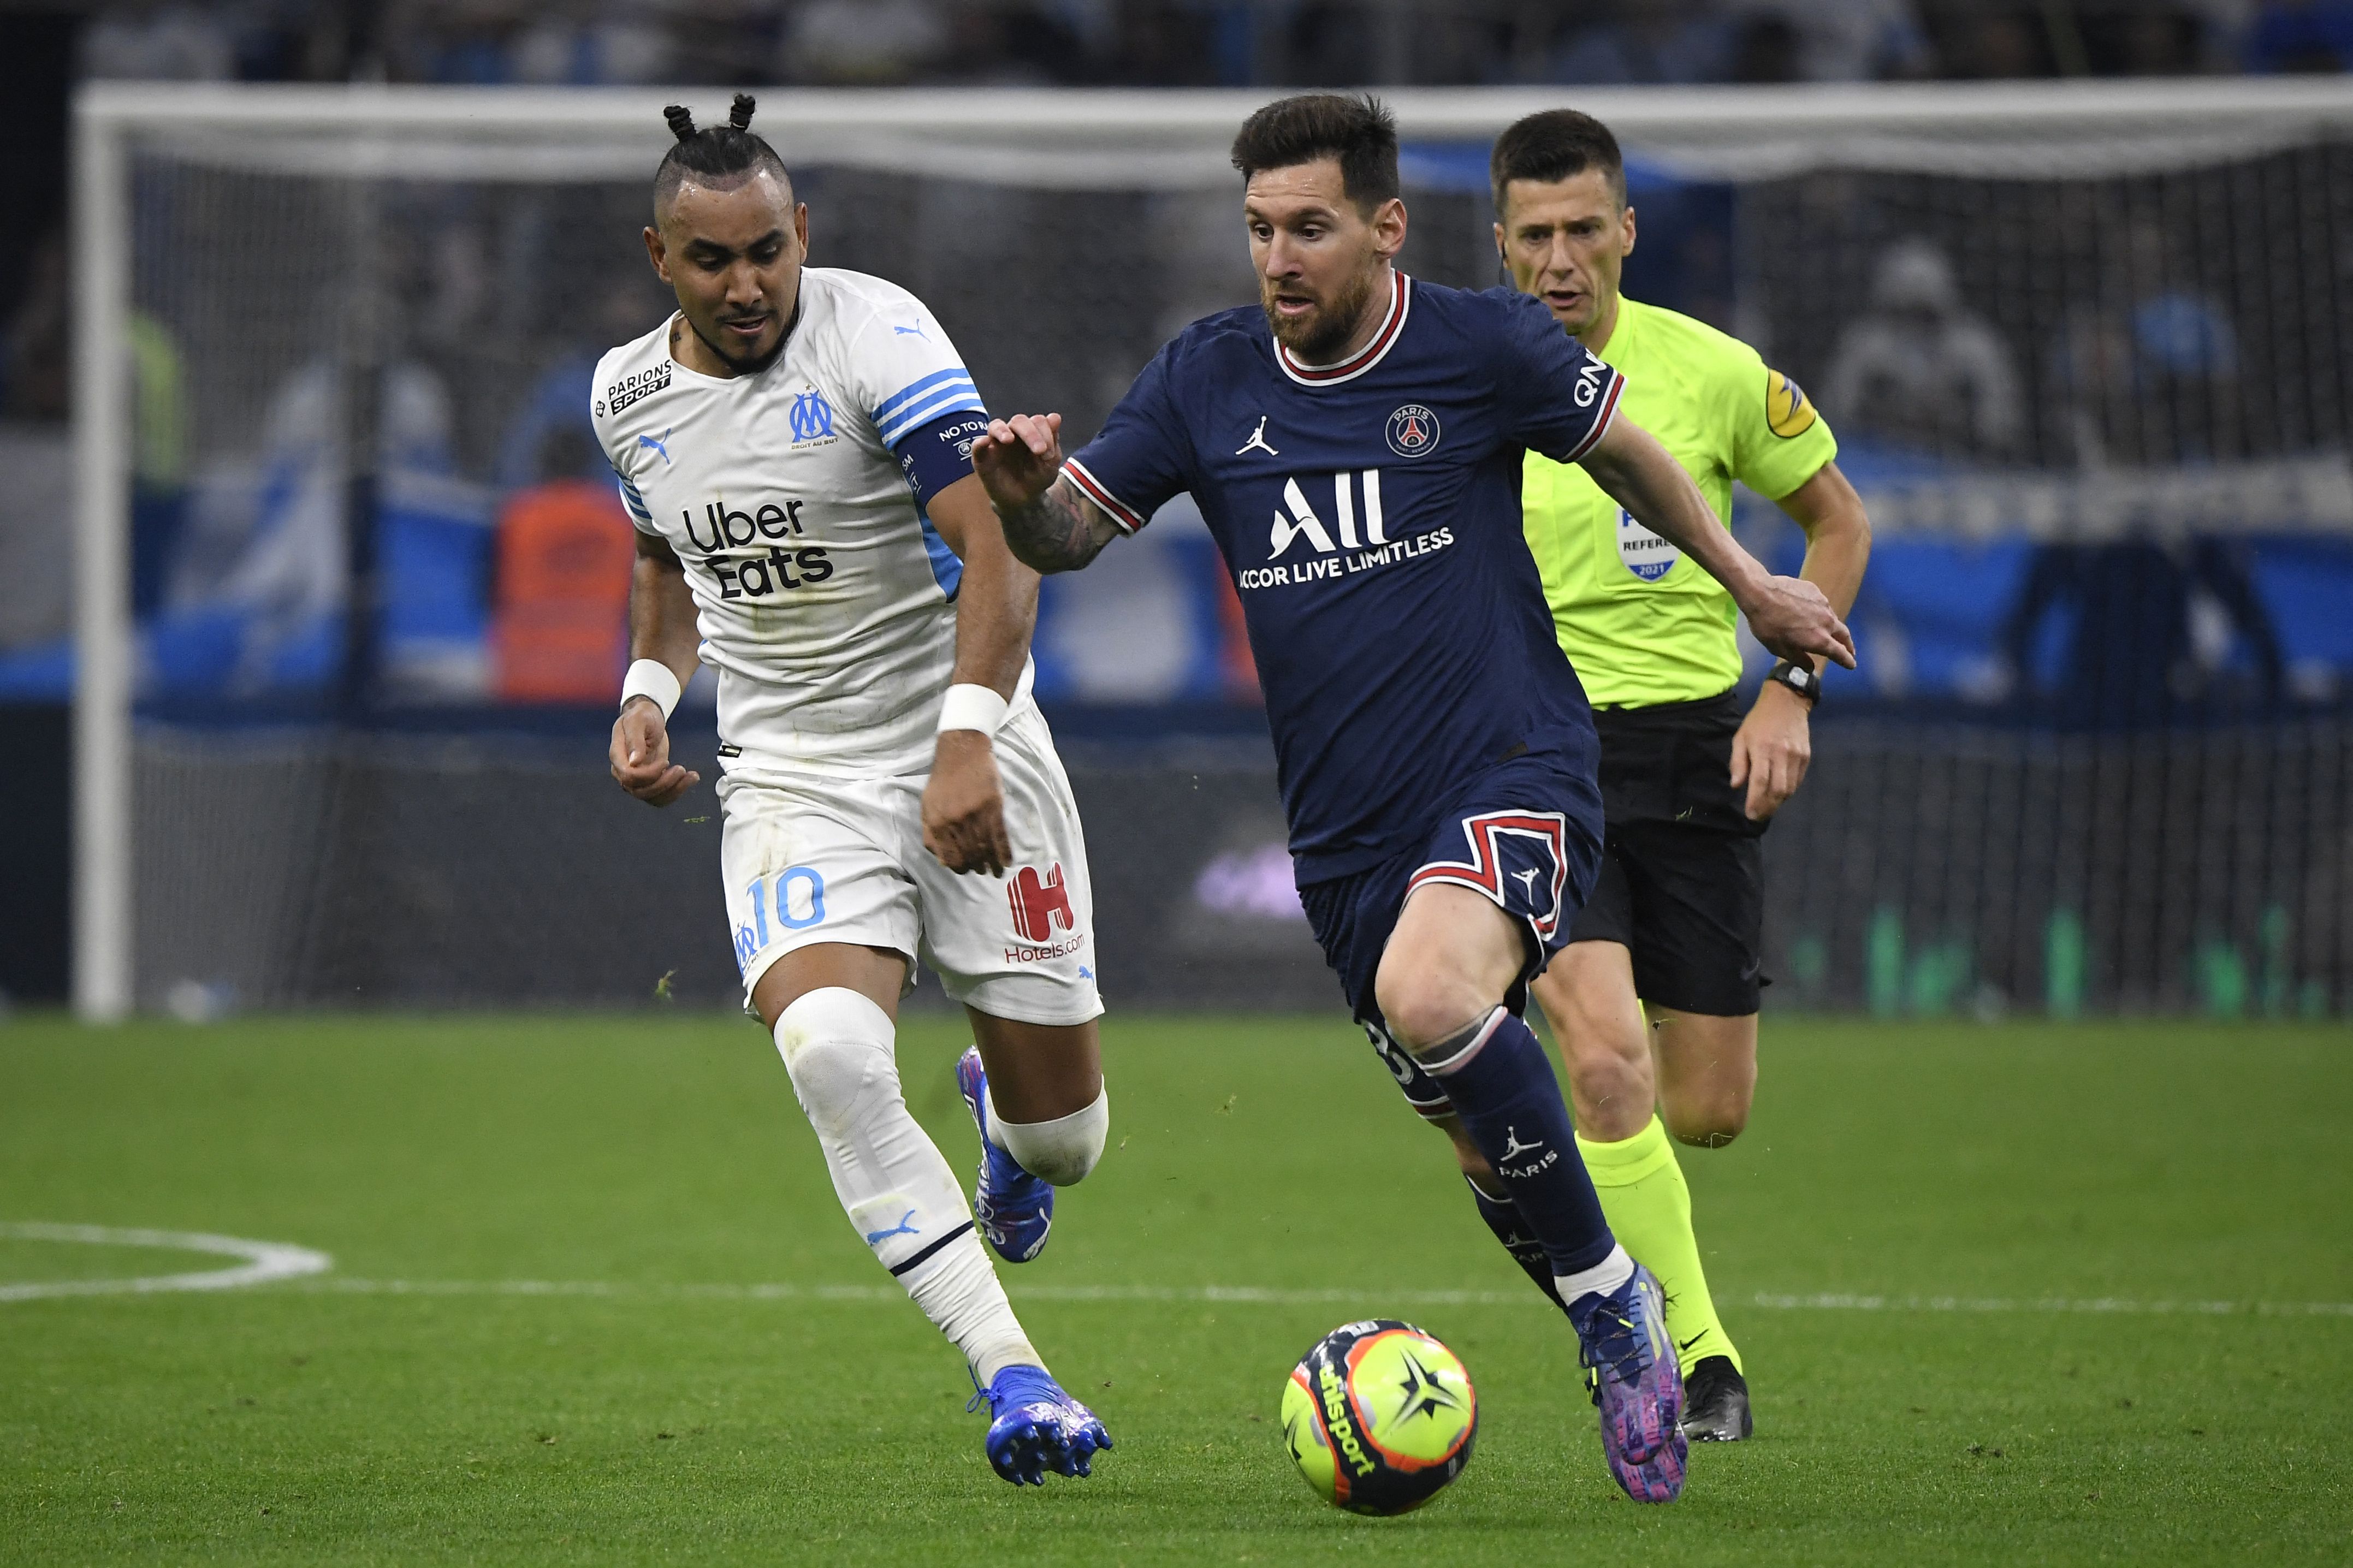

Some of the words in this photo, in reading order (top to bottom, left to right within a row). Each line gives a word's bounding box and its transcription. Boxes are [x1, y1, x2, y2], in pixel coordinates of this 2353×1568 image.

[608, 359, 672, 400] PARIONS
[613, 375, 670, 413] SPORT
[1574, 347, 1607, 407] QN
[939, 426, 961, 442] NO
[959, 421, 978, 432] TO
[1394, 407, 1430, 422] PARIS
[682, 500, 803, 554] Uber
[1623, 538, 1670, 551] REFERE
[703, 546, 834, 599] Eats
[1293, 557, 1343, 584] LIVE
[1345, 527, 1455, 573] LIMITLESS
[1639, 565, 1664, 576] 2021
[746, 866, 826, 946] 10
[1004, 933, 1086, 964] Hotels.com
[1498, 1149, 1558, 1177] PARIS
[1319, 1363, 1376, 1477] uhlsport
